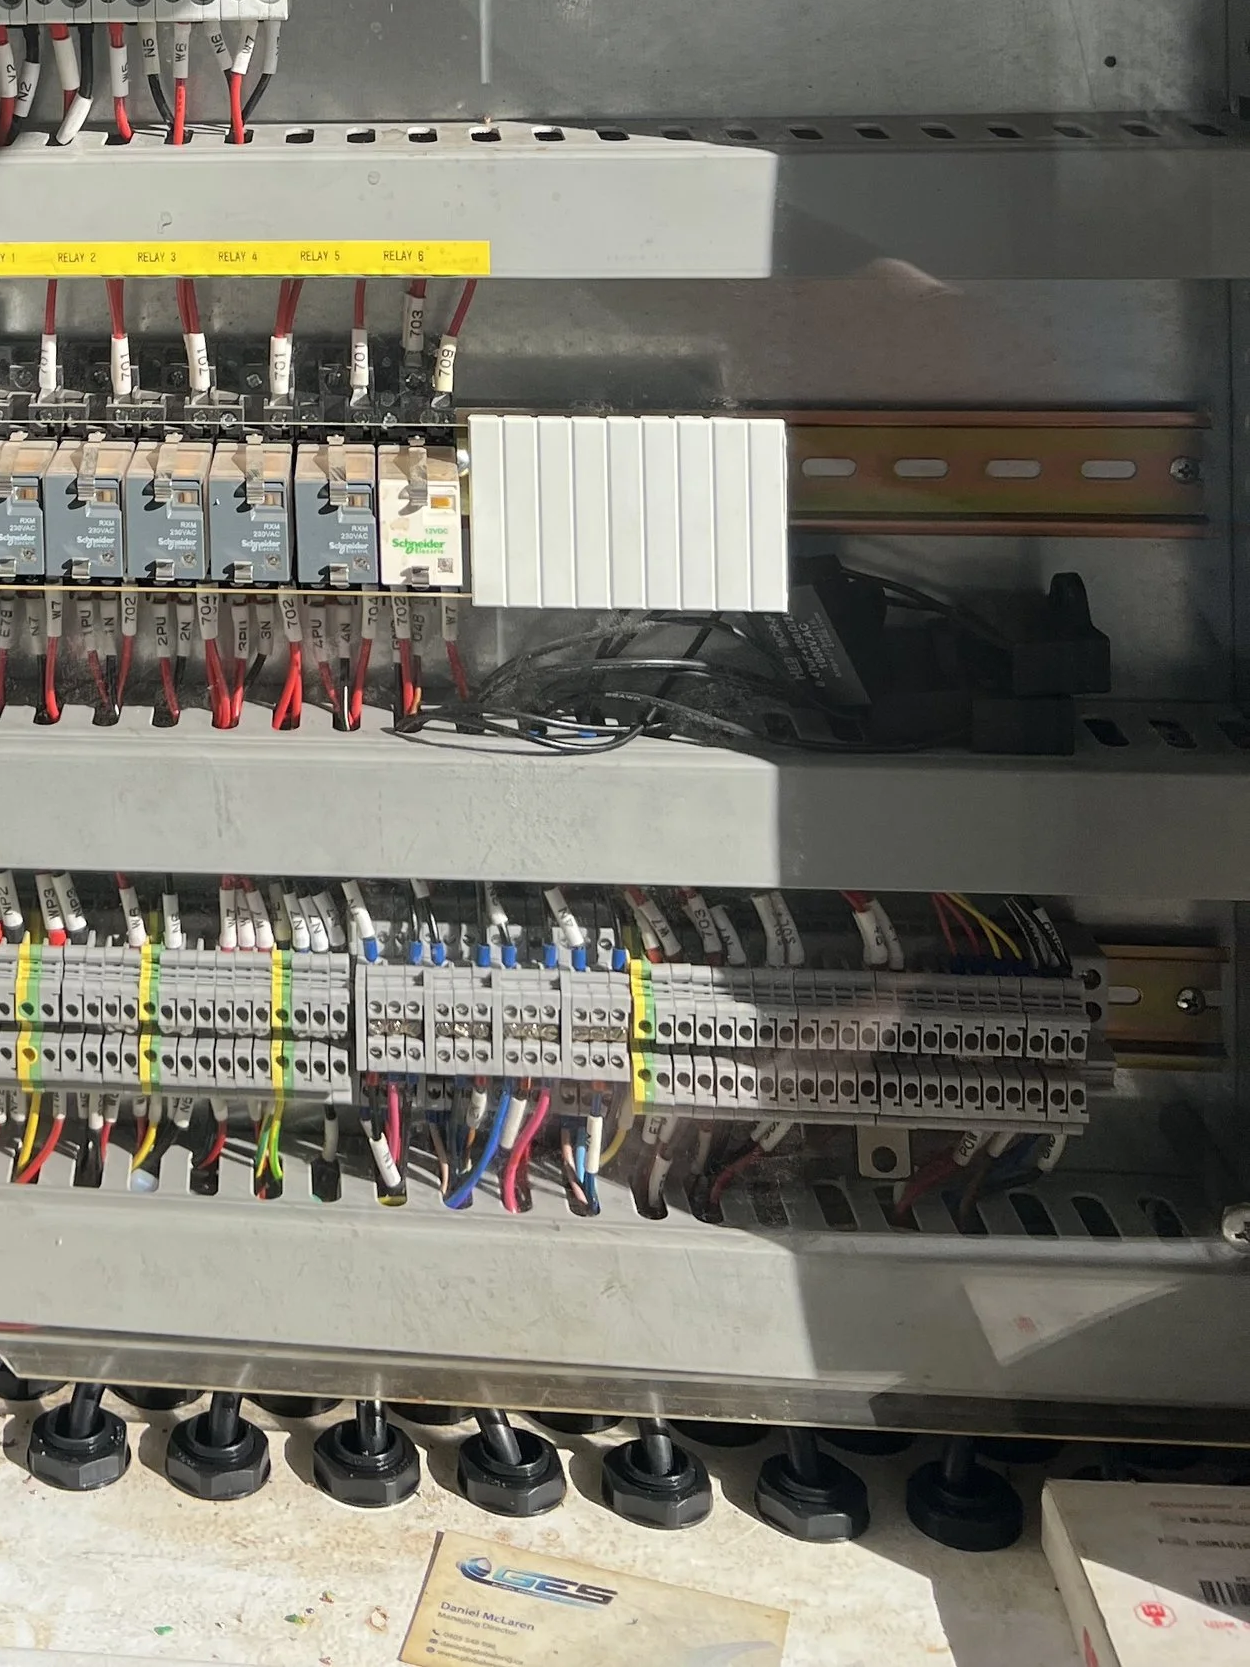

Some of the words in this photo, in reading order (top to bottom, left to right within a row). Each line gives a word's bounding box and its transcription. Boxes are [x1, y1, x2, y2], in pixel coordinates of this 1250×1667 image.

[144, 37, 155, 58] N5
[17, 82, 33, 103] N2
[11, 252, 15, 263] 1
[58, 252, 84, 263] RELAY
[90, 252, 97, 263] 2
[137, 252, 164, 263] RELAY
[170, 252, 176, 262] 3
[218, 251, 246, 263] RELAY
[252, 252, 257, 262] 4
[300, 251, 327, 262] RELAY
[334, 251, 340, 261] 5
[383, 250, 412, 262] RELAY
[418, 251, 424, 262] 6
[410, 309, 424, 338] 703
[120, 353, 131, 382] 701
[198, 348, 209, 376] 701
[274, 353, 287, 381] 701
[354, 344, 366, 375] 701
[438, 348, 455, 378] 709
[98, 519, 115, 527] RXM
[180, 521, 196, 529] RXM
[76, 535, 115, 548] Schneider
[158, 537, 197, 550] Schneider
[241, 539, 280, 552] Schneider
[329, 541, 369, 554] Schneider
[392, 538, 446, 554] Schneider
[51, 600, 61, 620] W7
[124, 596, 137, 624] 702
[200, 596, 212, 625] 704
[282, 598, 297, 629] 702
[367, 596, 379, 623] 704
[396, 596, 408, 623] 702
[445, 606, 457, 625] W7
[29, 616, 39, 637] N7
[157, 616, 169, 646] 2PU
[179, 620, 192, 641] 2N
[260, 620, 272, 639] 3N
[312, 619, 323, 649] 4PU
[0, 886, 13, 917] NP2
[47, 887, 61, 919] WP3
[65, 888, 83, 918] NP3
[290, 907, 304, 932] N7
[651, 917, 668, 942] W7
[697, 907, 711, 937] 703
[437, 1611, 481, 1630] Managing
[482, 1622, 518, 1637] Director
[440, 1601, 480, 1618] Daniel
[482, 1612, 536, 1631] McLaren
